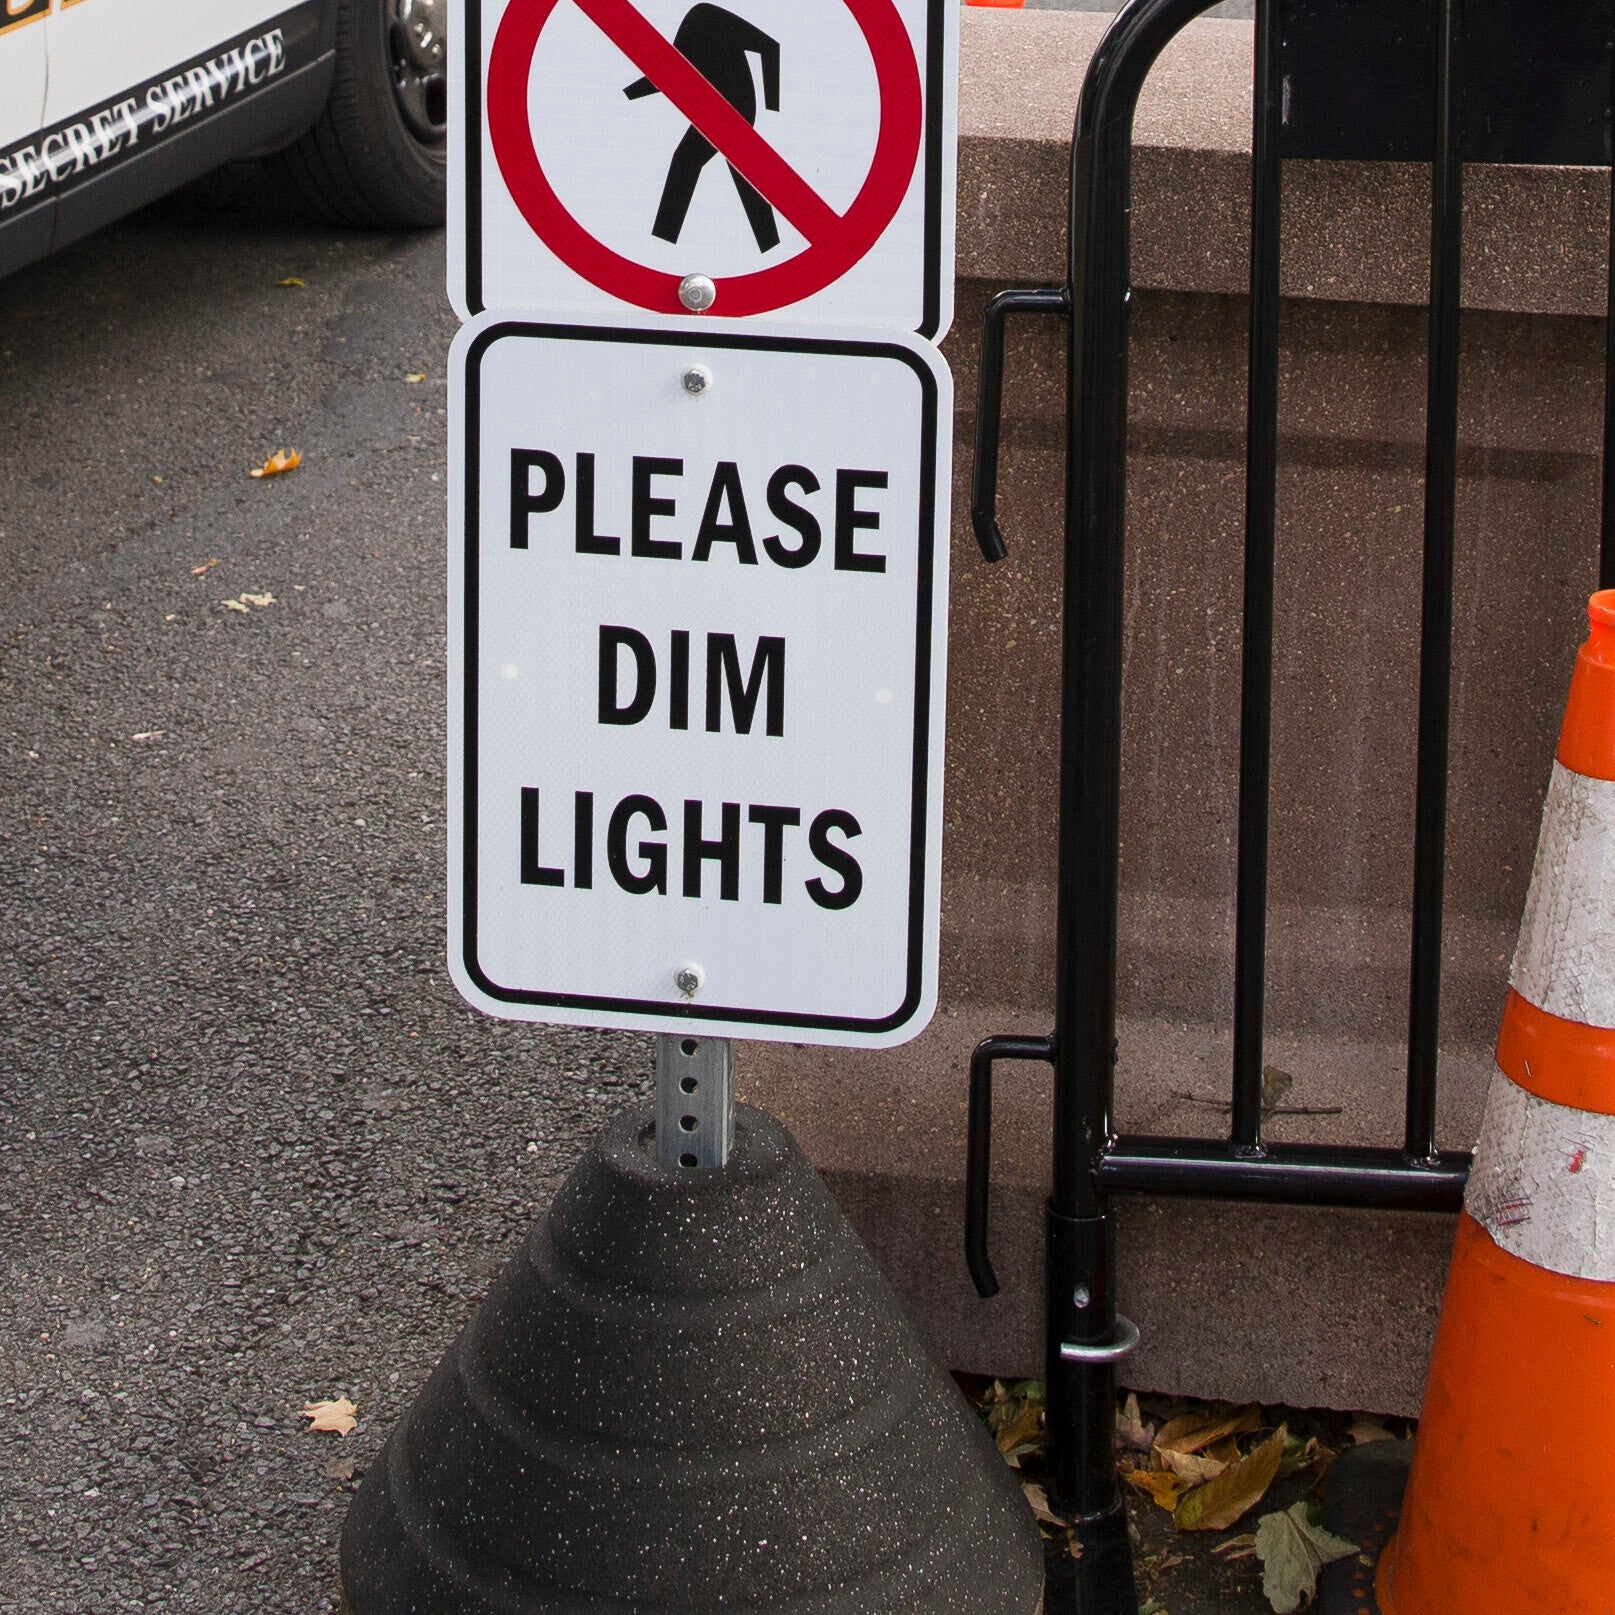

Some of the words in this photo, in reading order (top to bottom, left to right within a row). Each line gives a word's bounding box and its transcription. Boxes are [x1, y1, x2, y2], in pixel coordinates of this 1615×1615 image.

[145, 27, 286, 135] SERVICE
[509, 447, 889, 575] PLEASE
[596, 624, 787, 738] DIM
[519, 786, 864, 912] LIGHTS
